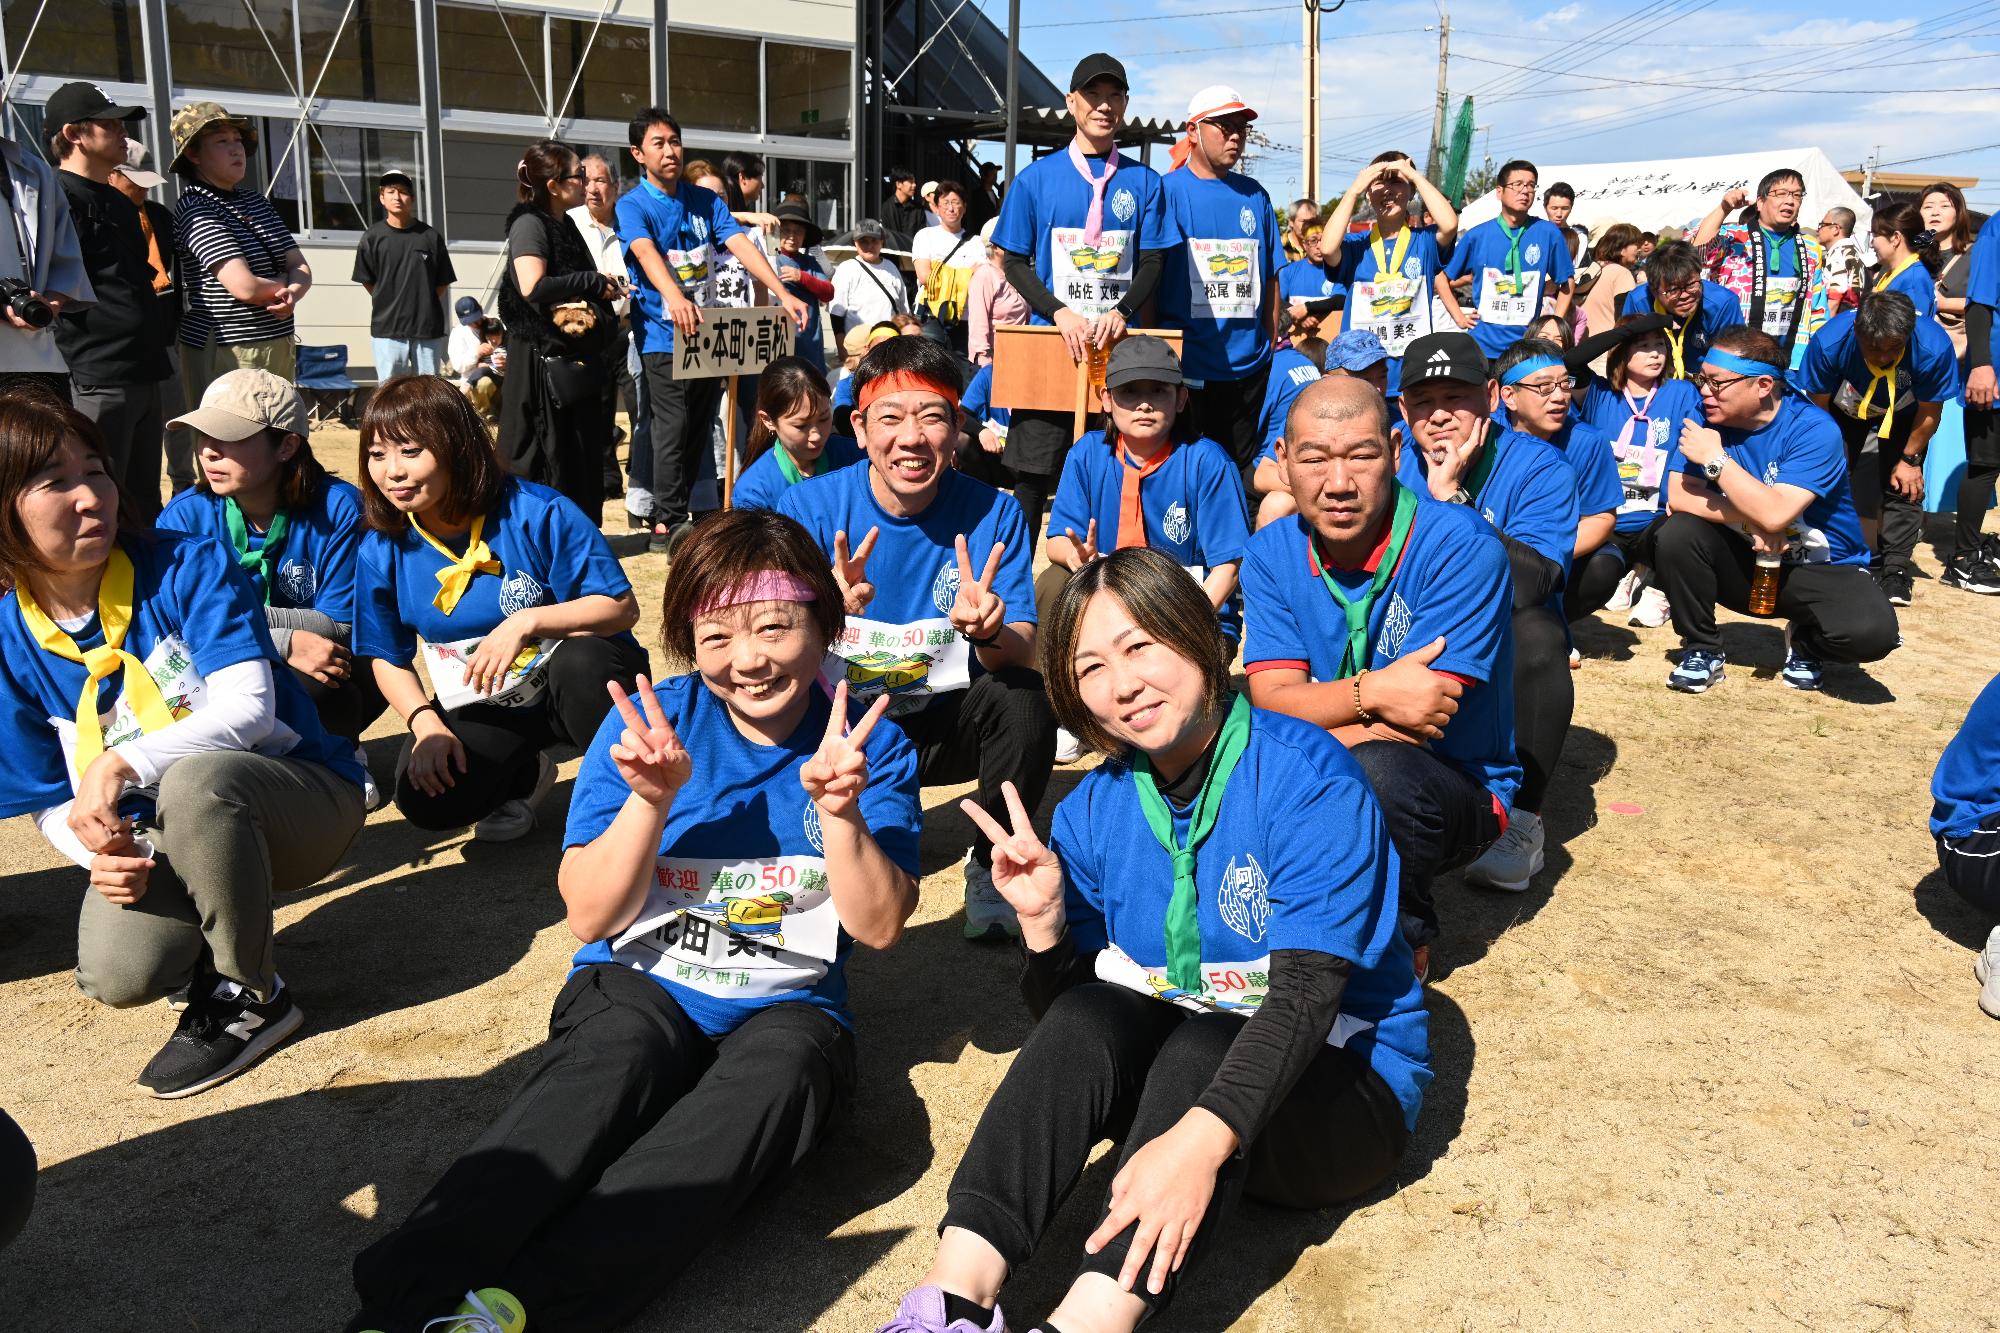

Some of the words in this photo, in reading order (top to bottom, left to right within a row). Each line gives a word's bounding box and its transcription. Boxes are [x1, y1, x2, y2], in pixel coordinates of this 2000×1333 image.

[1205, 283, 1229, 299] 松尾
[1516, 301, 1526, 312] 巧
[1393, 322, 1417, 340] 美冬
[1288, 365, 1322, 386] AKUN
[835, 627, 861, 645] 迎
[868, 627, 956, 649] 華の50歳組
[656, 865, 701, 892] 歓迎
[710, 864, 829, 893] 華の50歳組
[676, 963, 751, 987] 阿久根市
